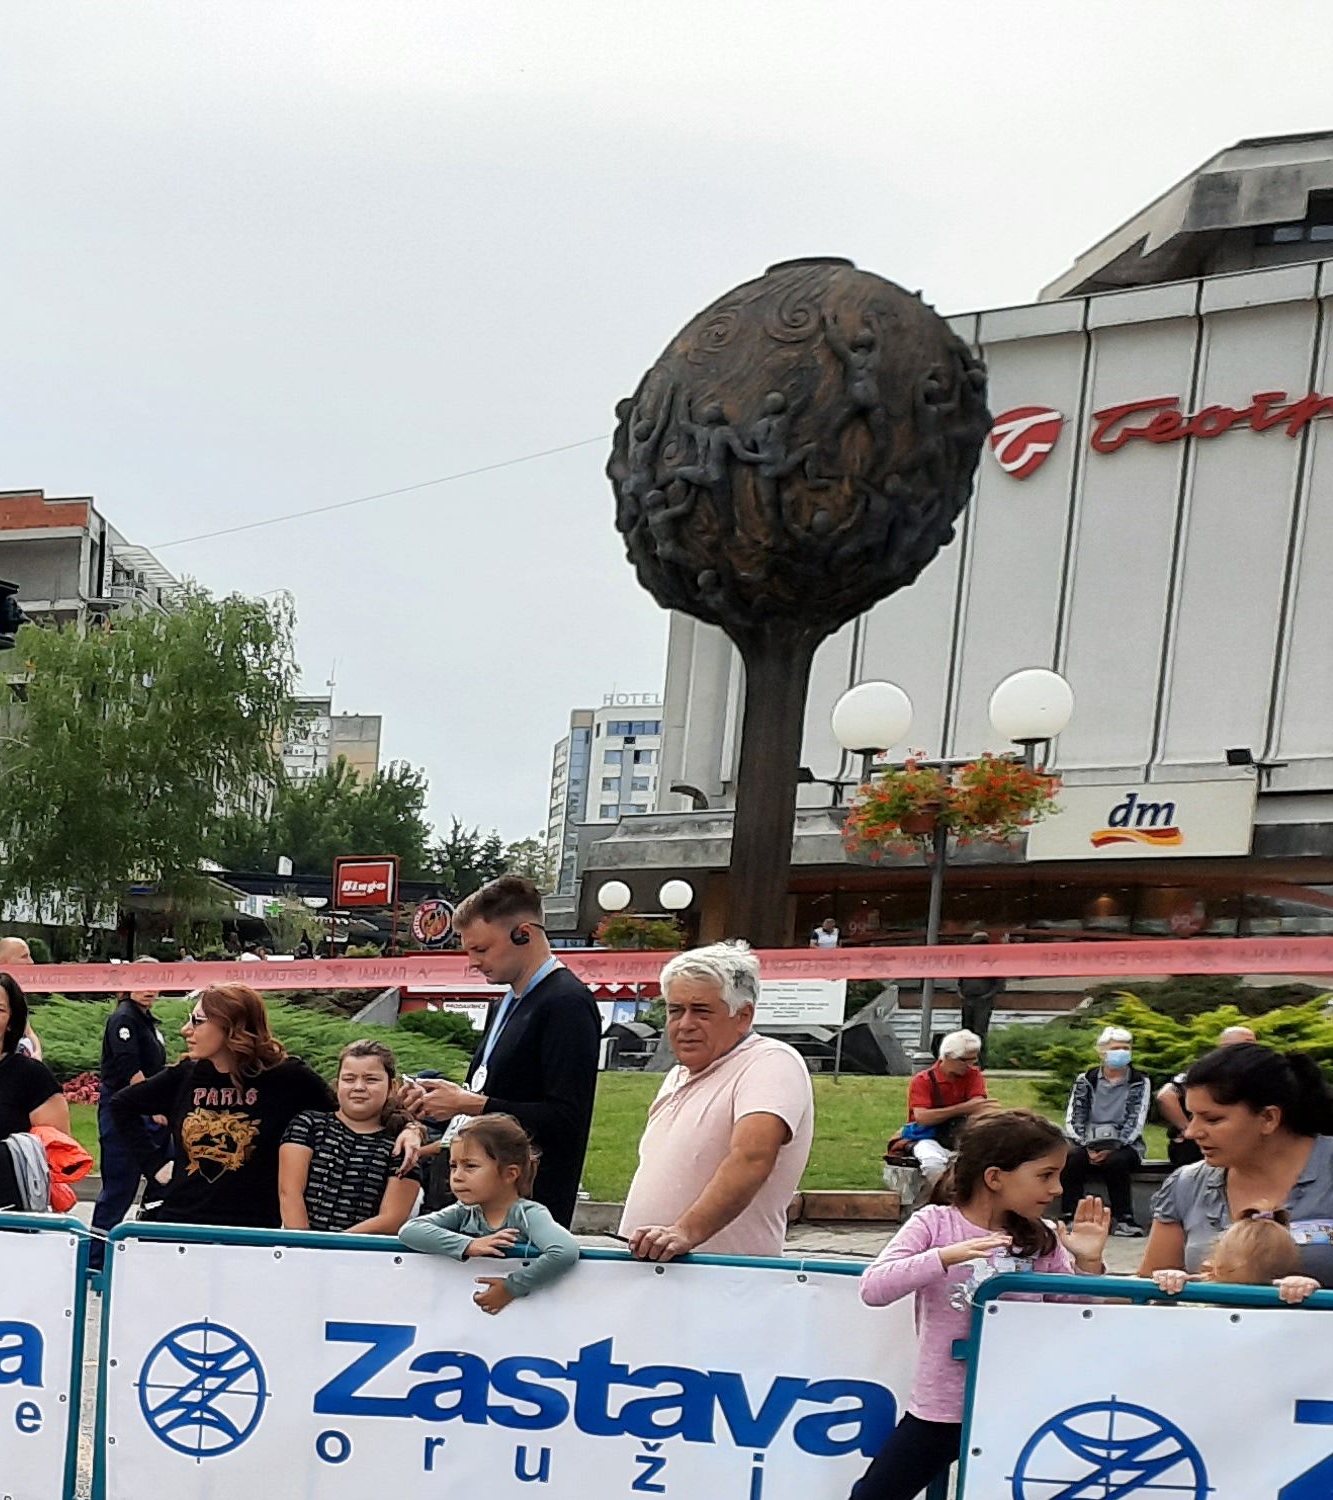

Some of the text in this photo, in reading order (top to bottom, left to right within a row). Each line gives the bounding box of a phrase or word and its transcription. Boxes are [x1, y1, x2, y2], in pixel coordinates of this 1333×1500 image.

[603, 692, 662, 706] HOTEL
[1108, 793, 1176, 828] dm
[341, 880, 386, 894] Bingo
[194, 1087, 259, 1106] PARIS
[313, 1320, 898, 1460] Zastava
